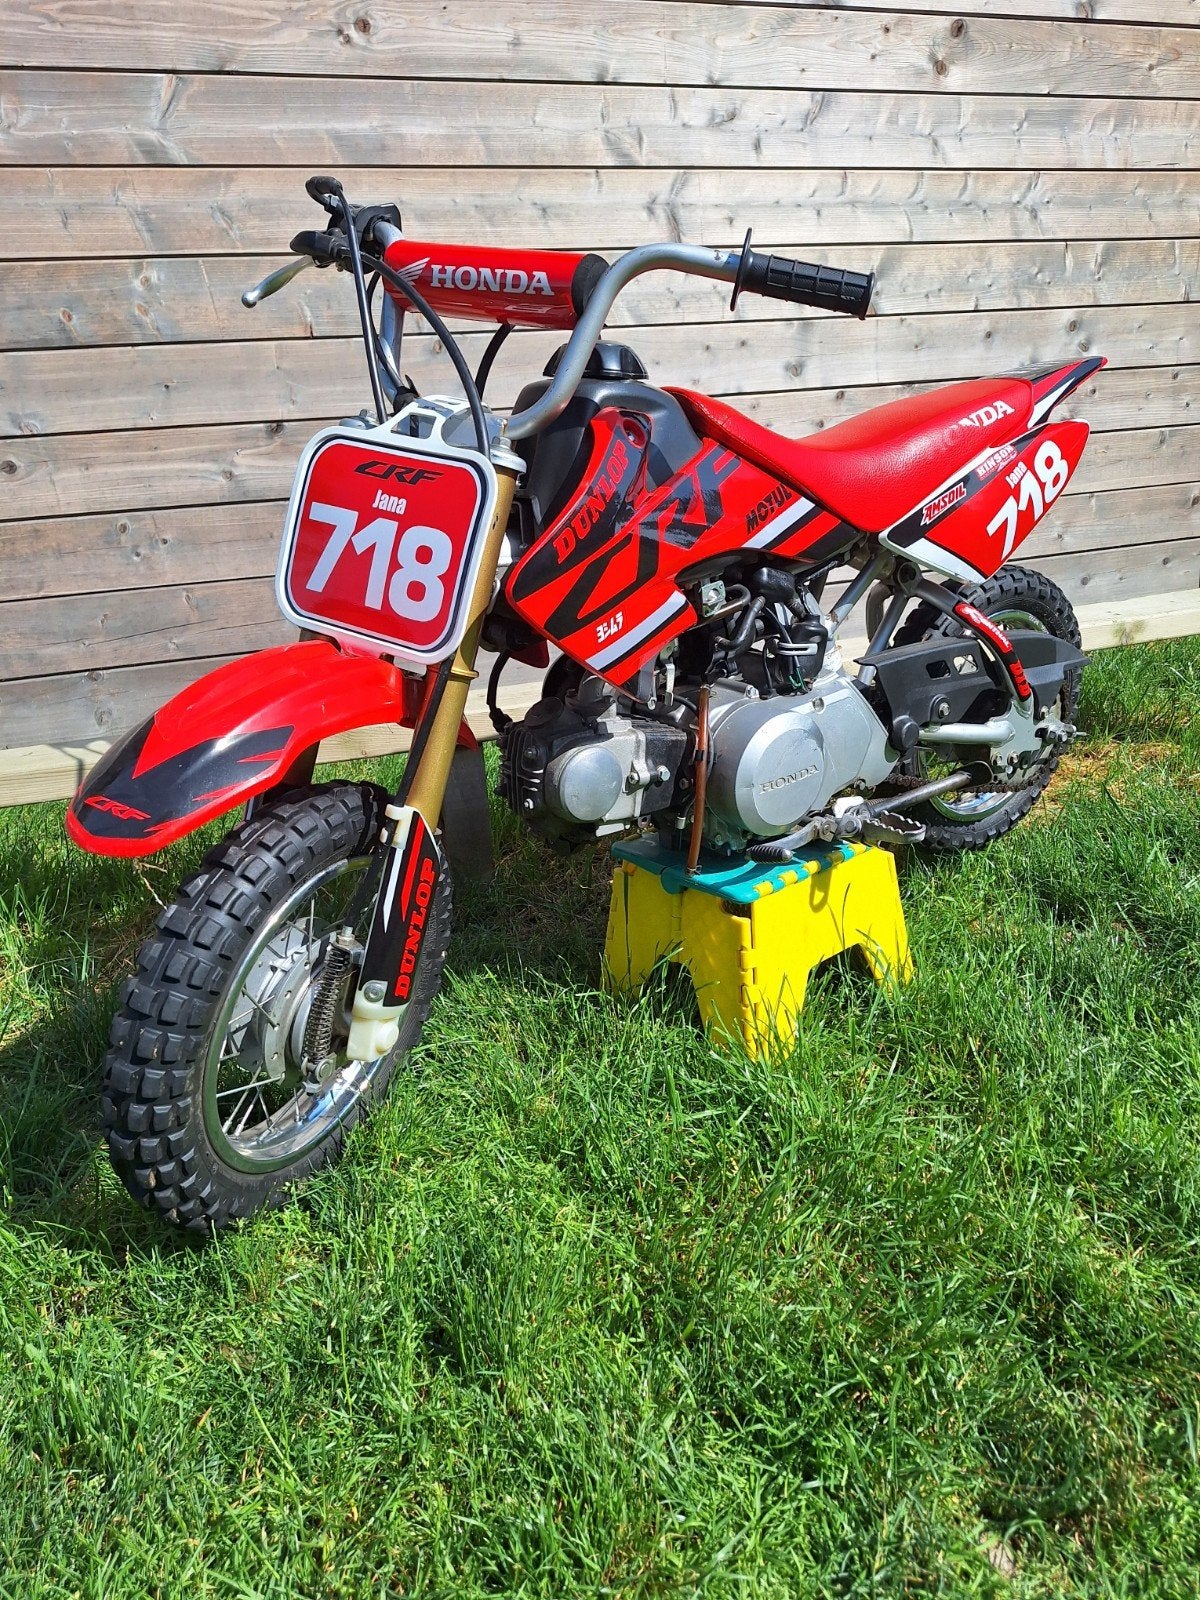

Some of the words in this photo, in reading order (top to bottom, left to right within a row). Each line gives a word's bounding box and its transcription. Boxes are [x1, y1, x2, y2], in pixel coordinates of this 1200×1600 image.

[430, 264, 555, 296] HONDA
[949, 399, 1016, 428] NDA
[354, 460, 445, 486] CRF
[1005, 461, 1028, 490] Jana
[371, 489, 407, 514] Jana
[553, 440, 629, 564] DUNLOP
[920, 482, 967, 526] AMSOIL
[986, 440, 1069, 561] 718
[306, 501, 452, 623] 718
[759, 764, 820, 795] HONDA
[84, 795, 152, 821] CRF
[394, 857, 436, 1000] DUNLOP
